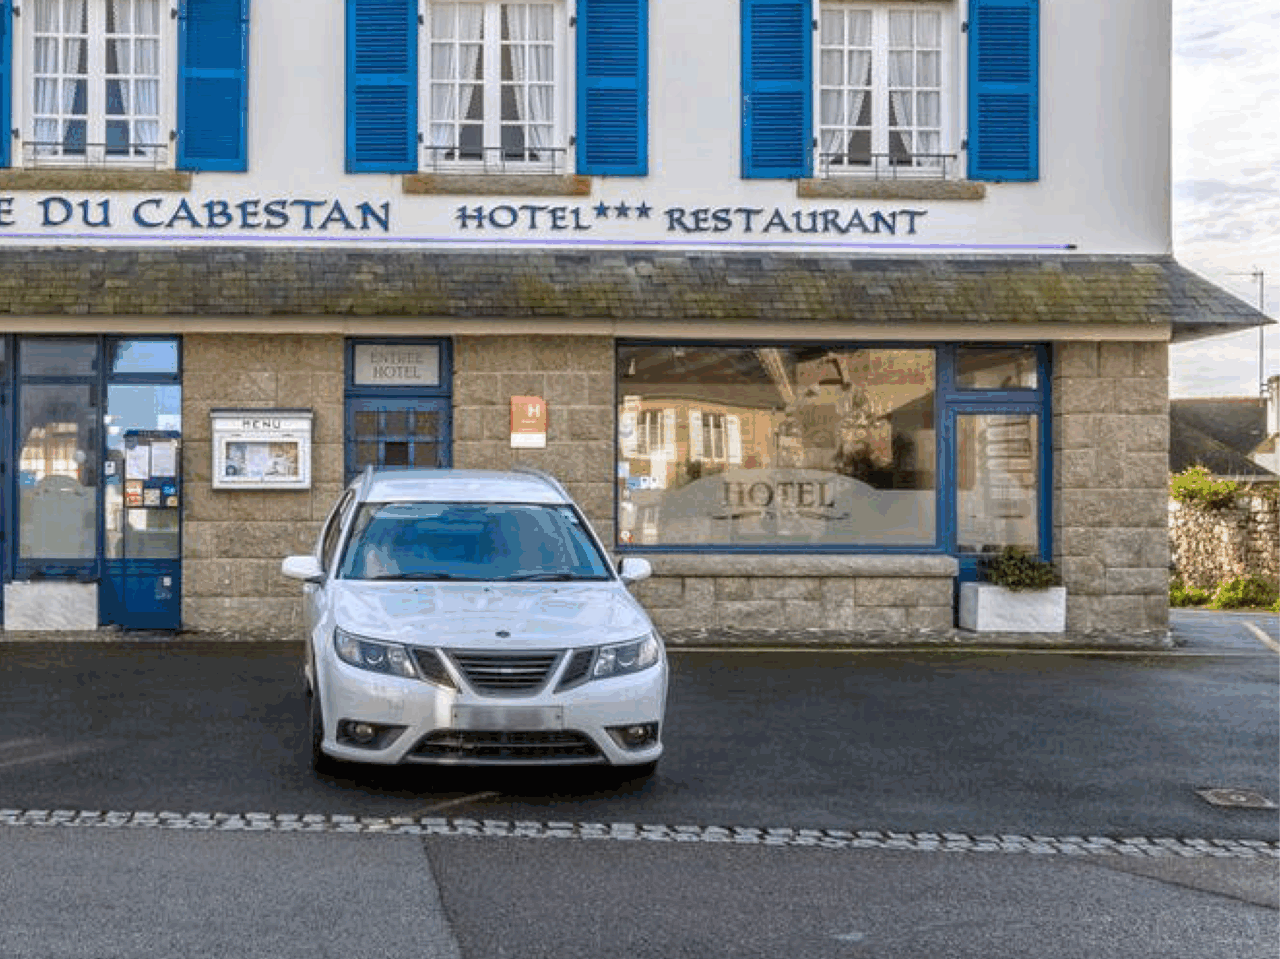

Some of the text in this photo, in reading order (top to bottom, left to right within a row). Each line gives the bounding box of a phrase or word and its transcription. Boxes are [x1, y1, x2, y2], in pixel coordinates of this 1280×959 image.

[37, 196, 111, 228] DU
[132, 197, 390, 232] CABESTAN
[664, 206, 928, 235] RESTAURANT
[372, 366, 422, 379] HOTEL
[242, 418, 281, 430] MENU
[723, 482, 836, 508] HOTEL
